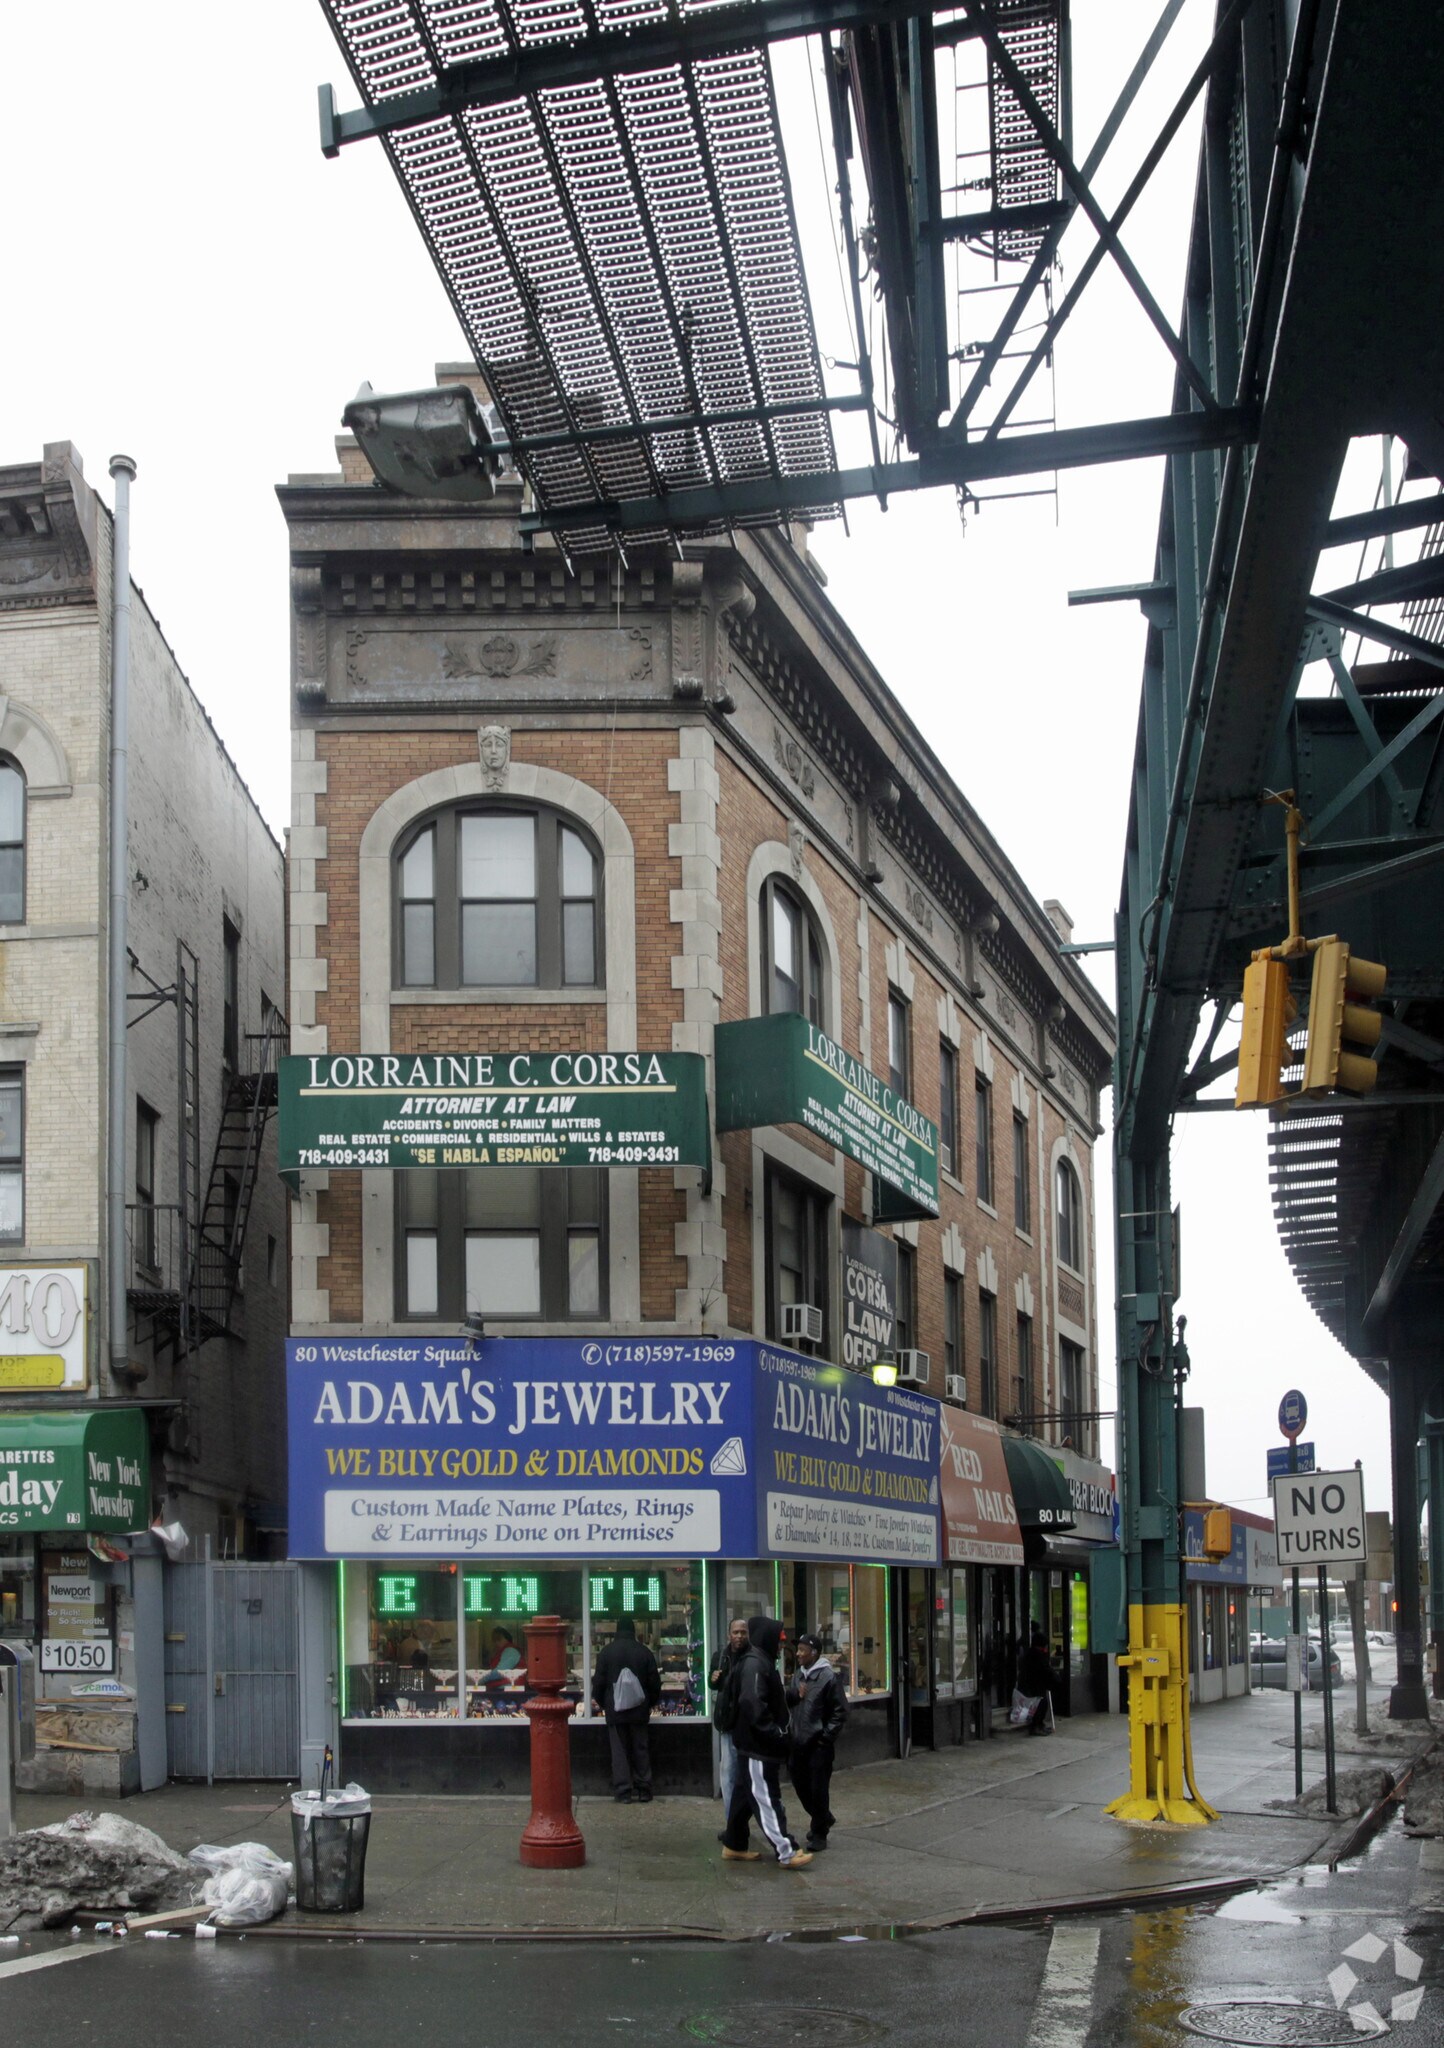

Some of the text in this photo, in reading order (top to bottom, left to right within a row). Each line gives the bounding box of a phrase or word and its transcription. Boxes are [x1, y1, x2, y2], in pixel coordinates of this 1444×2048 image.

[308, 1054, 667, 1088] LORRAINE C. CORSA
[808, 1024, 932, 1147] LORRAINE C. CORSA
[400, 1096, 577, 1114] ATTORNEY AT LAW
[844, 1090, 908, 1151] ATTORNEY AT LAW
[318, 1131, 665, 1145] REAL ESTATE COMMERCIAL & RESIDENTIAL WILLS & ESTATES
[382, 1118, 601, 1130] ACCIDENTS DIVORCE FAMILY MATTERS
[298, 1149, 389, 1165] 718-409-3431
[443, 1148, 490, 1163] HABLA
[588, 1147, 679, 1162] 718-409-3431
[846, 1254, 877, 1280] LORRAINE
[846, 1266, 888, 1313] CORSA
[847, 1301, 892, 1346] LAW
[295, 1345, 735, 1368] 80 Westchester Square (718)597-1969
[843, 1332, 881, 1366] OFFI
[768, 1353, 816, 1381] (718)597-1969
[313, 1367, 731, 1435] ADAM'S JEWELRY
[773, 1380, 932, 1463] ADAM'S JEWELRY
[88, 1451, 142, 1487] New York
[326, 1447, 704, 1479] WE BUY GOLD & DIAMONDS
[773, 1450, 928, 1505] WE BUY GOLD & DIAMONDS
[950, 1443, 983, 1483] RED
[0, 1470, 64, 1515] day
[89, 1486, 135, 1526] Newsday
[972, 1487, 1017, 1525] NAILS
[1090, 1484, 1115, 1517] BLOCK
[1291, 1484, 1345, 1517] NO
[351, 1497, 694, 1524] Custom Made Name Plates, Rings
[780, 1500, 804, 1525] Repair
[804, 1503, 831, 1526] Jewelry
[839, 1508, 867, 1526] Watches
[1039, 1509, 1053, 1523] 80
[1056, 1509, 1072, 1523] LAW
[371, 1523, 675, 1549] & Earrings Done on Premises
[774, 1523, 784, 1541] &
[785, 1525, 821, 1544] Diamonds
[871, 1536, 895, 1551] Custom
[1280, 1526, 1361, 1553] TURNS
[50, 1585, 91, 1599] Newport
[379, 1577, 415, 1611] E
[463, 1577, 538, 1611] IN
[47, 1608, 58, 1616] So
[58, 1617, 105, 1625] So Smooth!
